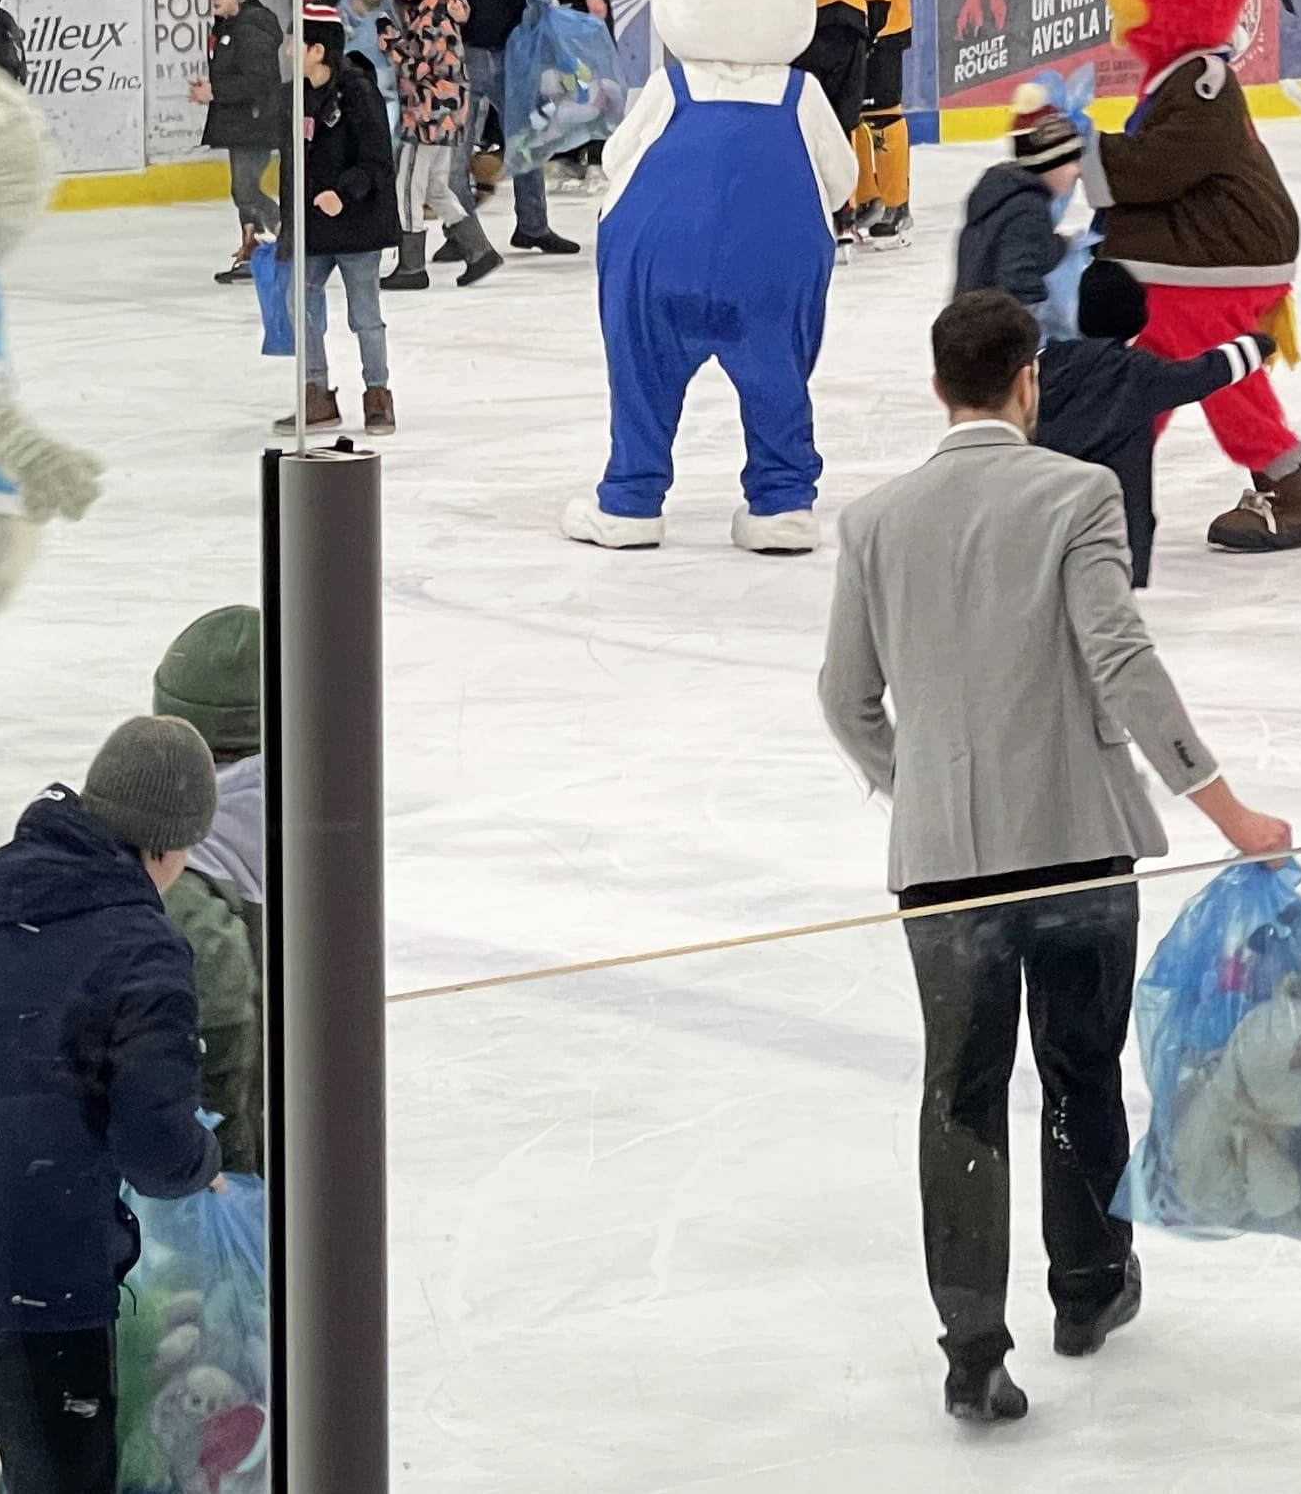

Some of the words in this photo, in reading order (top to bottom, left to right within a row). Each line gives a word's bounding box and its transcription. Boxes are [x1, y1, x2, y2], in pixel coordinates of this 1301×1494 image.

[958, 34, 1006, 59] POULET
[1031, 20, 1075, 57] AVEC
[1078, 11, 1100, 41] LA
[155, 62, 174, 79] BY
[954, 49, 1008, 83] ROUGE
